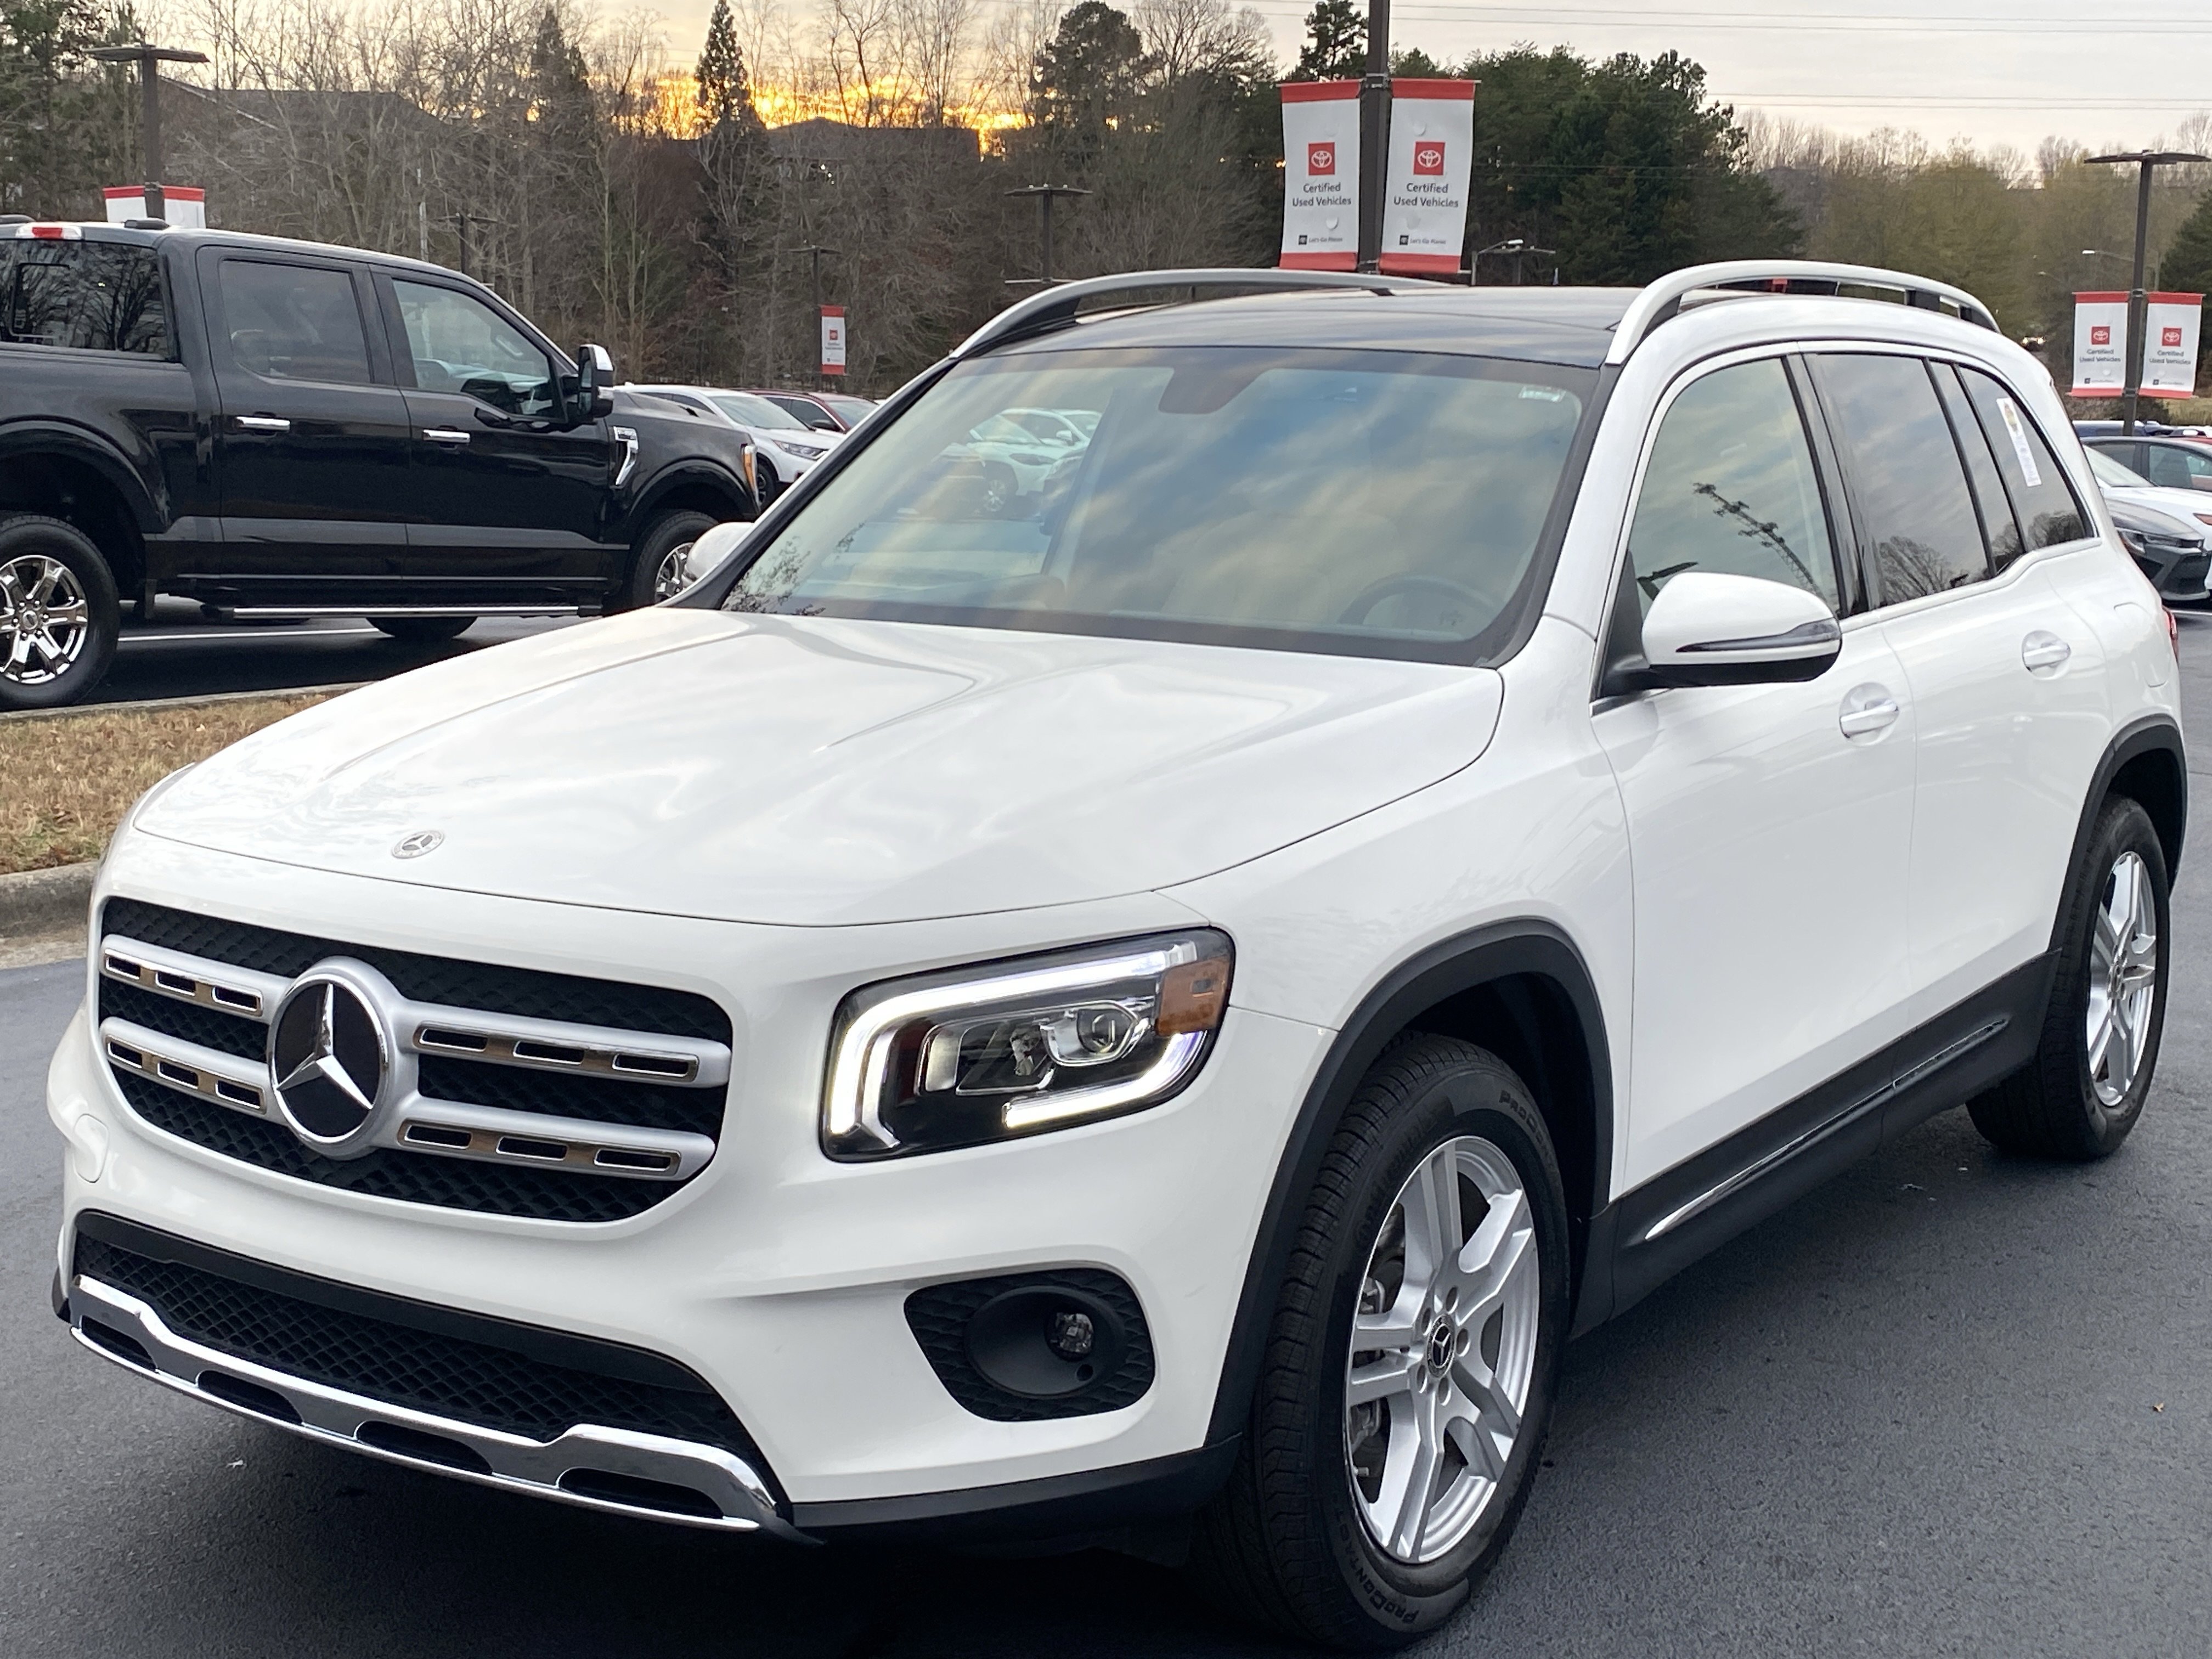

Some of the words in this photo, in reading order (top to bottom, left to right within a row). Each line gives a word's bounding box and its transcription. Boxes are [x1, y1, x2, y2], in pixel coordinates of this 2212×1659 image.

[1303, 182, 1341, 193] Certified
[1406, 182, 1449, 194] Certified
[1292, 197, 1314, 207] Used
[1316, 195, 1352, 206] Vehicles
[1393, 196, 1418, 206] Used
[1420, 197, 1459, 207] Vehicles
